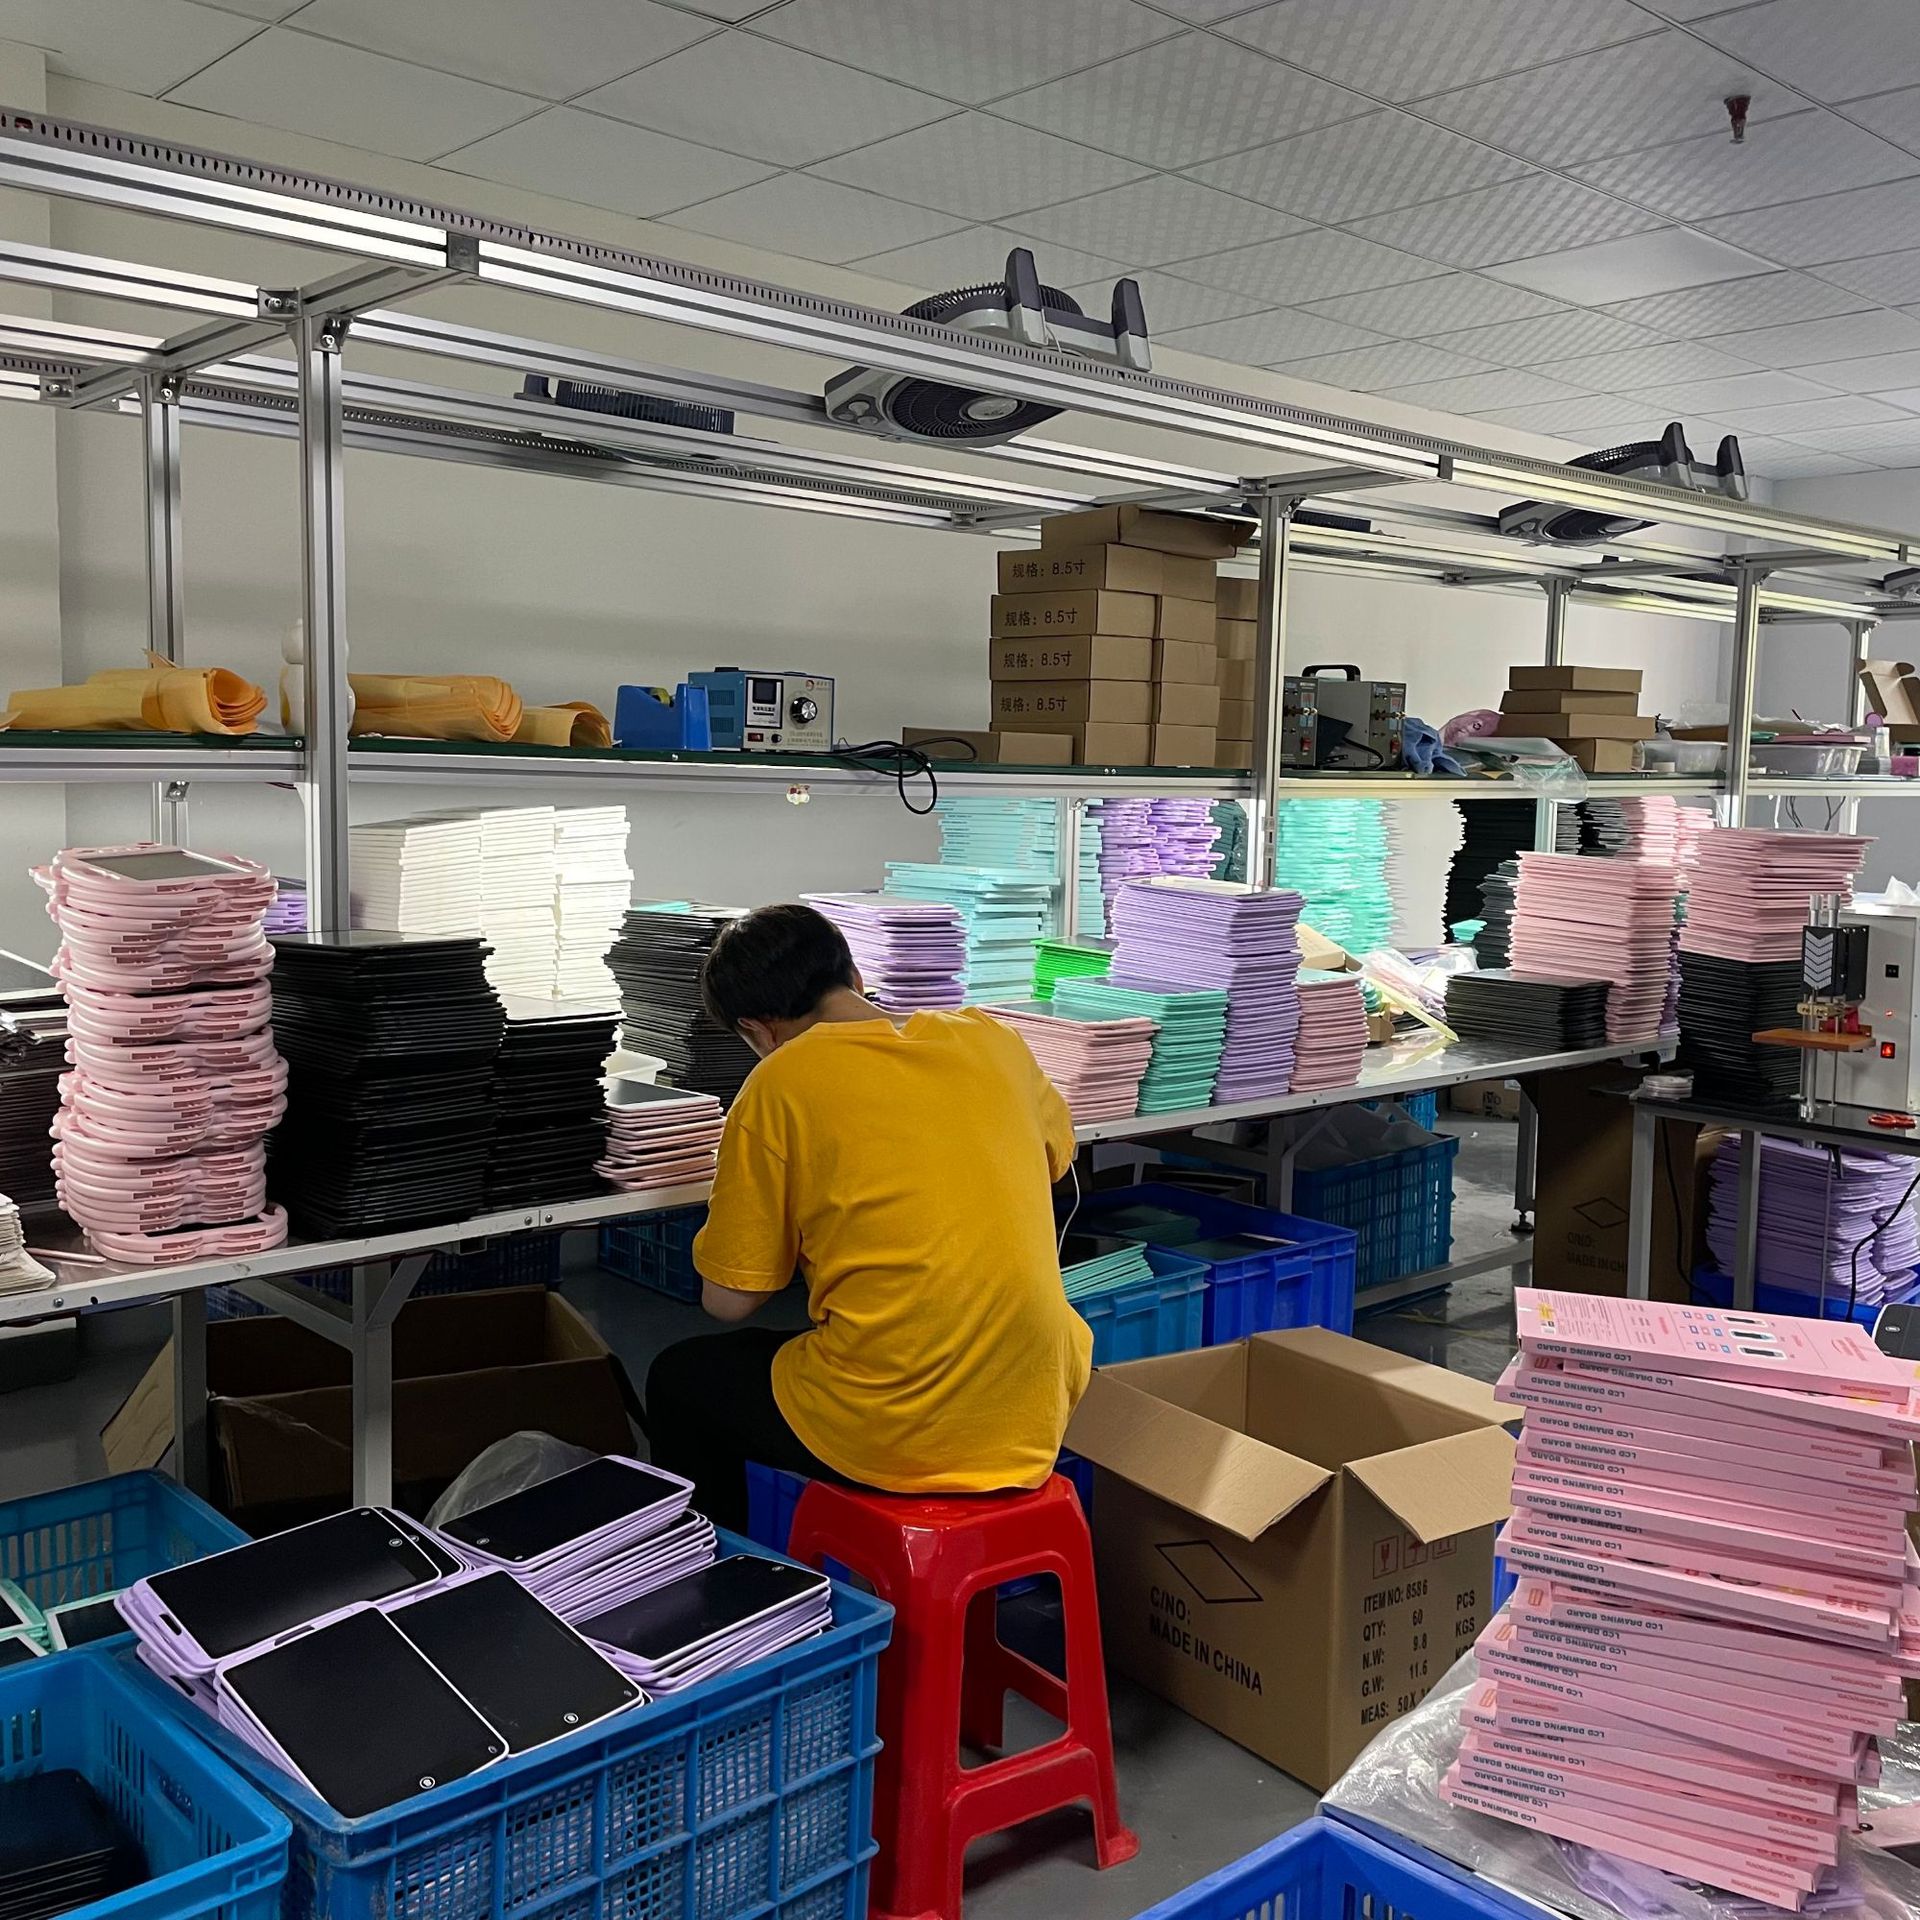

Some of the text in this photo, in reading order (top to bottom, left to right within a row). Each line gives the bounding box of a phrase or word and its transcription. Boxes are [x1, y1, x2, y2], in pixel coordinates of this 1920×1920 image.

[1537, 1343, 1632, 1362] LCD DRAWING BOARD
[1579, 1362, 1673, 1386] LCD DRAWING BOARD
[1531, 1377, 1625, 1398] LCD DRAWING BOARD
[1509, 1391, 1603, 1413] LCD DRAWING BOARD
[1539, 1417, 1634, 1439] LCD DRAWING BOARD
[1541, 1438, 1636, 1459] LCD DRAWING BOARD
[1531, 1451, 1625, 1474] LCD DRAWING BOARD
[1529, 1473, 1624, 1496] LCD DRAWING BOARD
[1527, 1495, 1622, 1518] LCD DRAWING BOARD
[1547, 1512, 1643, 1534] LCD DRAWING BOARD
[1527, 1527, 1622, 1550] LCD DRAWING BOARD
[1510, 1547, 1605, 1572] LCD DRAWING BOARD
[1521, 1563, 1616, 1588] LCD DRAWING BOARD
[1363, 1592, 1387, 1614] ITEM
[1387, 1587, 1404, 1606] NO:
[1363, 1590, 1475, 1642] QTY: 60 PCS
[1525, 1615, 1620, 1639] LCD DRAWING BOARD
[1567, 1609, 1663, 1630] LCD DRAWING BOARD
[1150, 1613, 1262, 1696] MADE IN CHINA
[1362, 1617, 1475, 1670] N.W: 9.8 KGS
[1532, 1631, 1627, 1656] LCD DRAWING BOARD
[1488, 1650, 1518, 1662] BOARD
[1519, 1658, 1560, 1673] DRAWING
[1524, 1646, 1618, 1672] LCD DRAWING BOARD
[1361, 1660, 1428, 1698] G.W: 11.6
[1494, 1668, 1584, 1698] LCD DRAWING BOARD
[1561, 1668, 1579, 1678] LCD
[1360, 1702, 1389, 1726] MEAS:
[1511, 1716, 1605, 1738] LCD DRAWING BOARD
[1493, 1741, 1585, 1766] LCD DRAWING BOARD
[1473, 1755, 1564, 1782] LCD DRAWING BOARD
[1474, 1771, 1565, 1797] LCD DRAWING BOARD
[1452, 1792, 1537, 1823] LCD DRAWING BOARD
